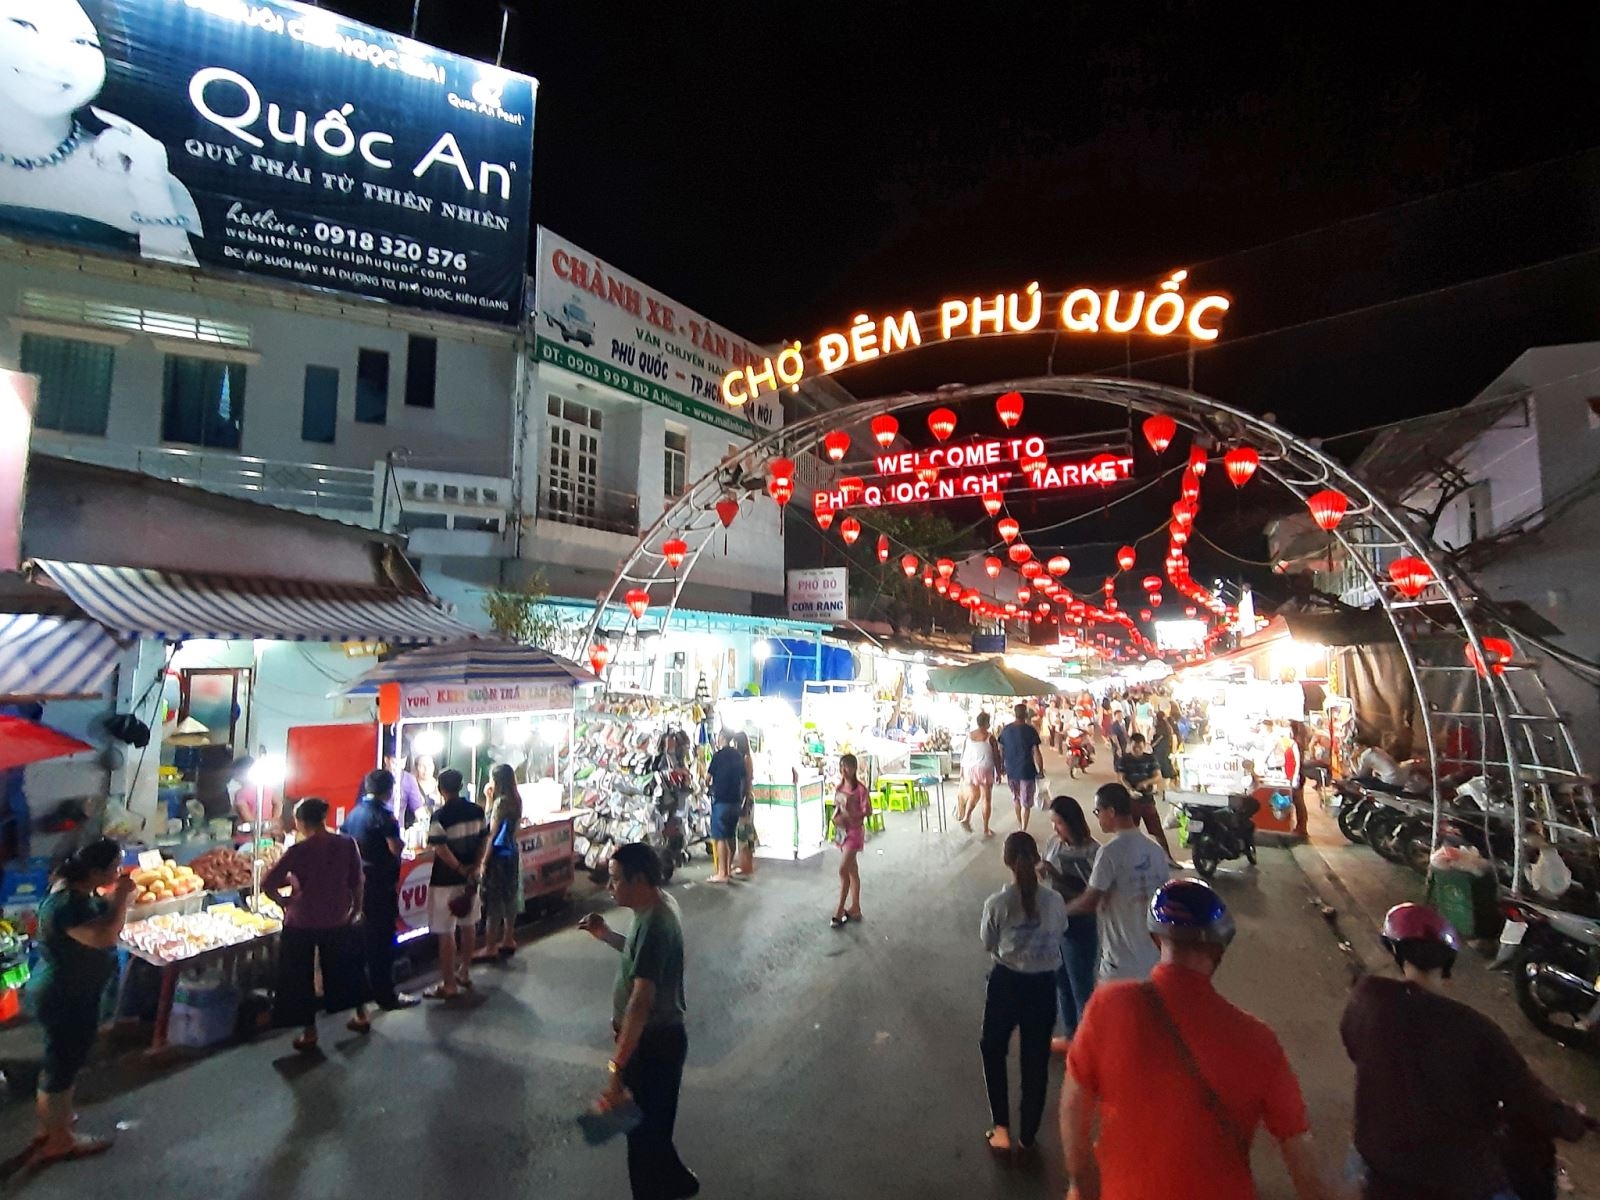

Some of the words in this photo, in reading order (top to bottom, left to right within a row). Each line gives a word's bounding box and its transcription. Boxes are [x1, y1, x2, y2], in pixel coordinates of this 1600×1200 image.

[189, 67, 394, 169] Quốc
[362, 182, 433, 213] THIÊN
[441, 202, 510, 232] NHIÊN
[314, 222, 374, 251] 0918
[379, 235, 422, 261] 320
[427, 246, 467, 271] 576
[552, 248, 642, 319] CHÀNH
[646, 296, 676, 334] XE
[689, 319, 727, 362] TÂN
[611, 338, 636, 367] PHÚ
[638, 350, 669, 381] QUỐC
[722, 340, 804, 406] CHỢ
[819, 313, 922, 371] ĐÊM
[941, 281, 1042, 340] PHÚ
[1062, 269, 1230, 341] QUỐC
[567, 354, 599, 377] 0903
[603, 369, 629, 389] 999
[633, 381, 649, 398] 812
[1008, 436, 1045, 461] TO
[816, 600, 844, 611] RANG
